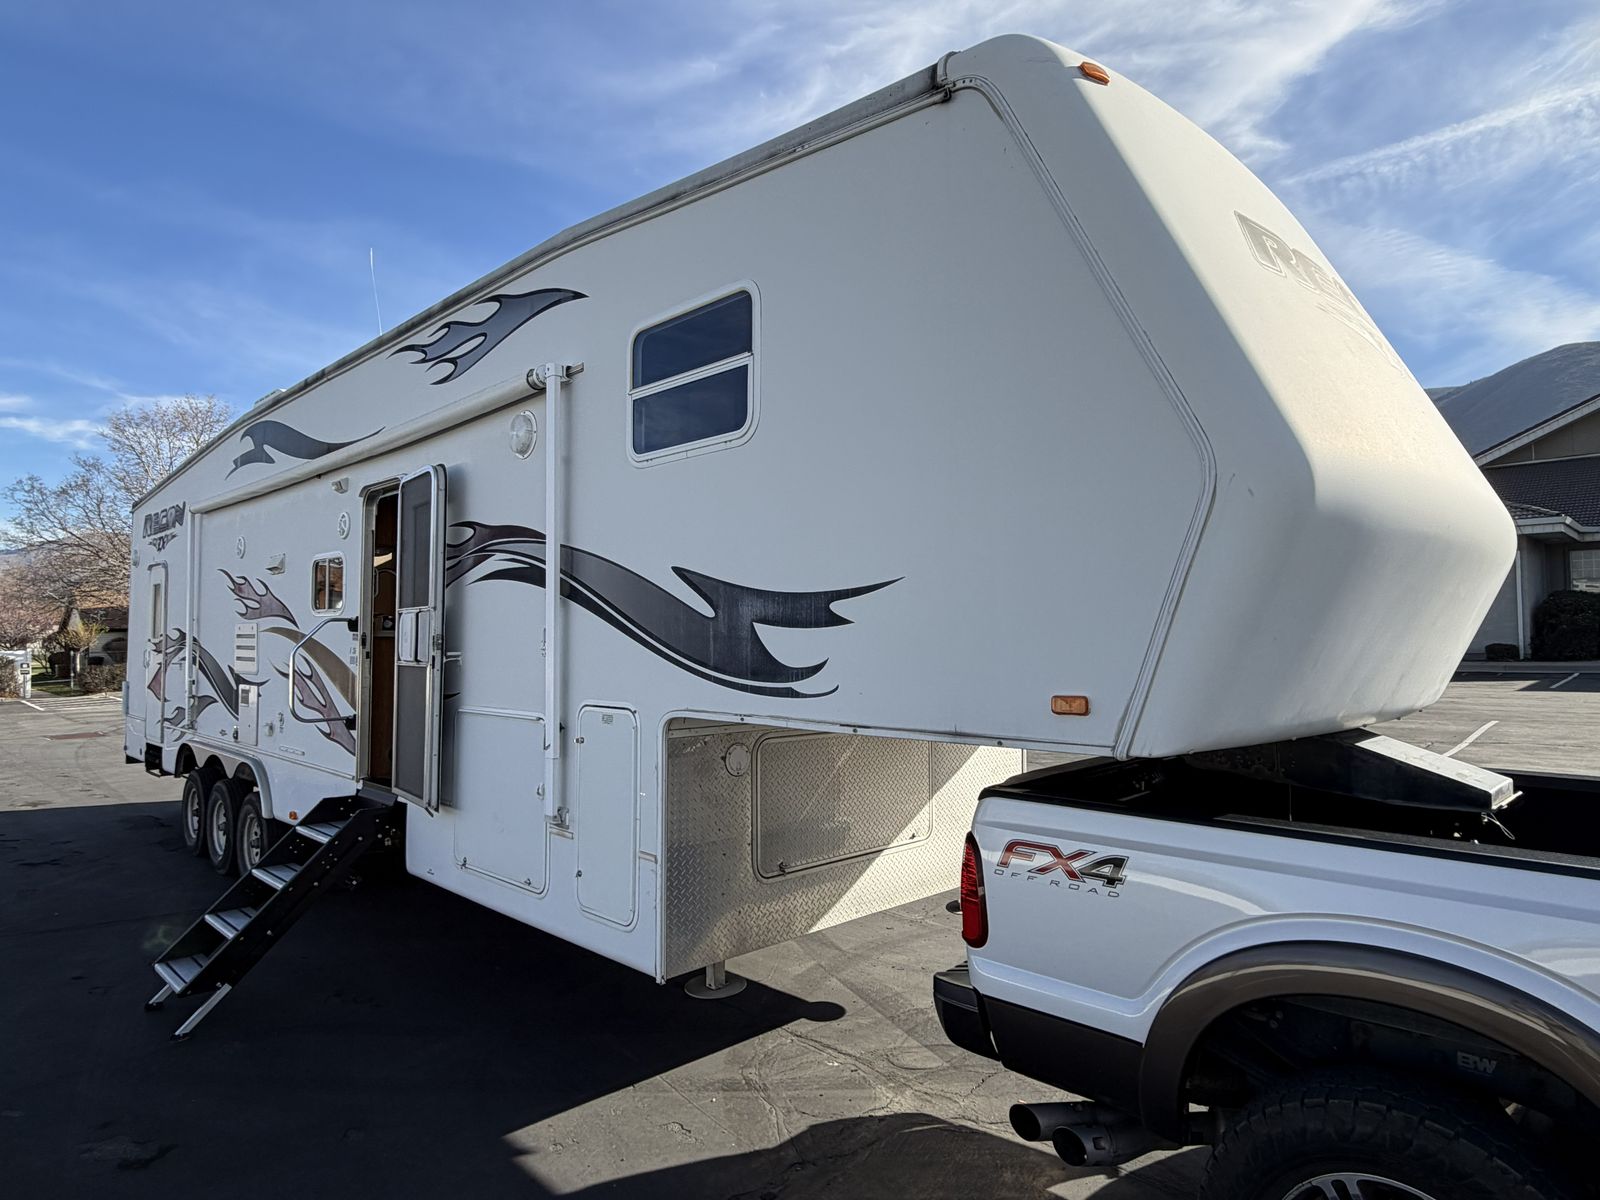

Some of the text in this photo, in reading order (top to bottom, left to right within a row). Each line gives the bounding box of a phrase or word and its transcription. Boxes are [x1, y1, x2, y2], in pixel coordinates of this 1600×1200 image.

[143, 501, 186, 539] RECON
[997, 839, 1129, 888] FX4
[994, 868, 1120, 898] OFF ROAD
